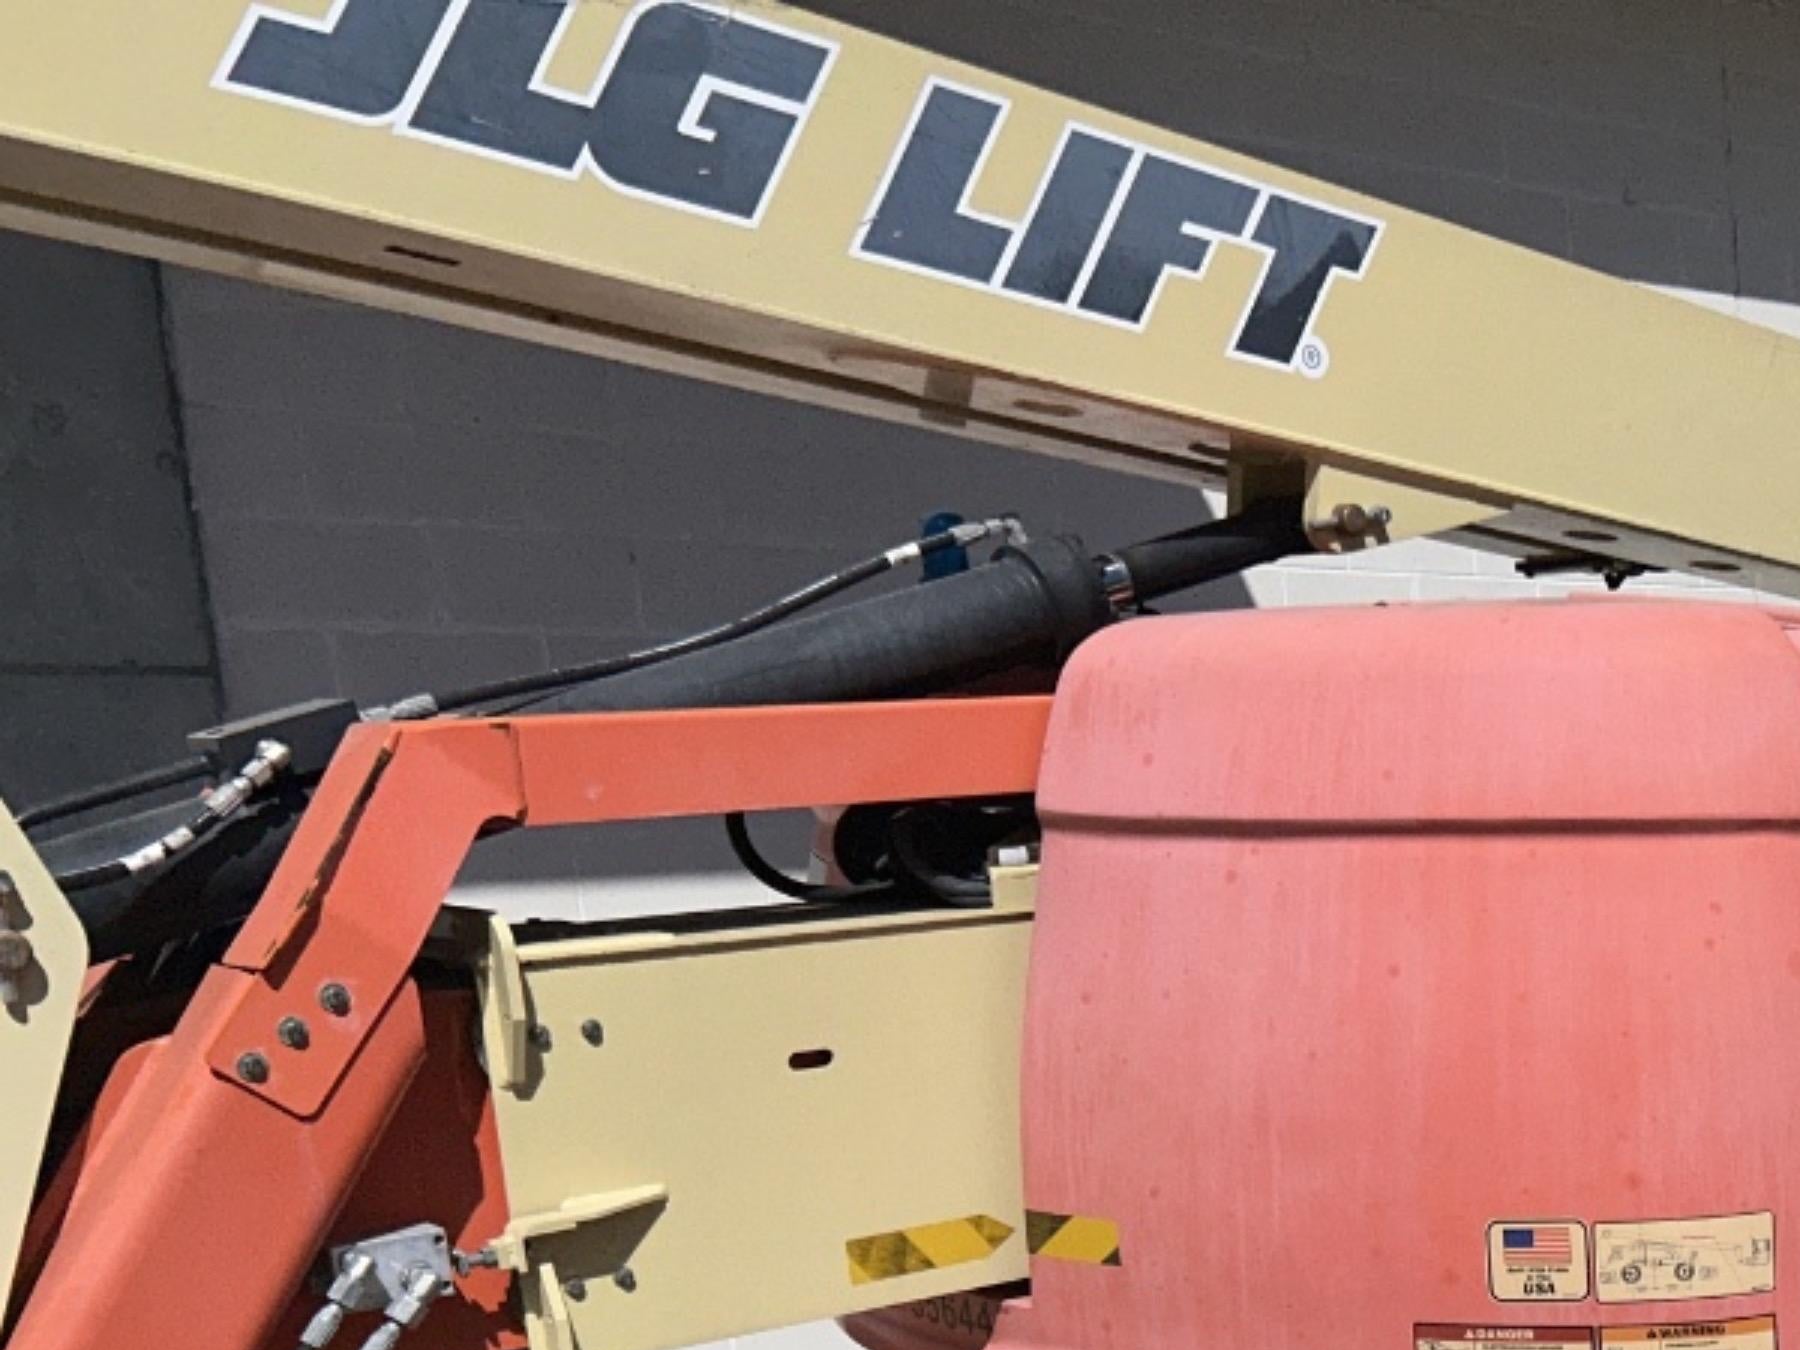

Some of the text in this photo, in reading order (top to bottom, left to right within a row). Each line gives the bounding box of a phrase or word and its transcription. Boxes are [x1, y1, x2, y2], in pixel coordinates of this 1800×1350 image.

[209, 0, 1386, 373] JLG LIFT
[1523, 1283, 1555, 1297] USA
[1477, 1328, 1534, 1339] DANGER
[1658, 1324, 1726, 1339] WARNING
